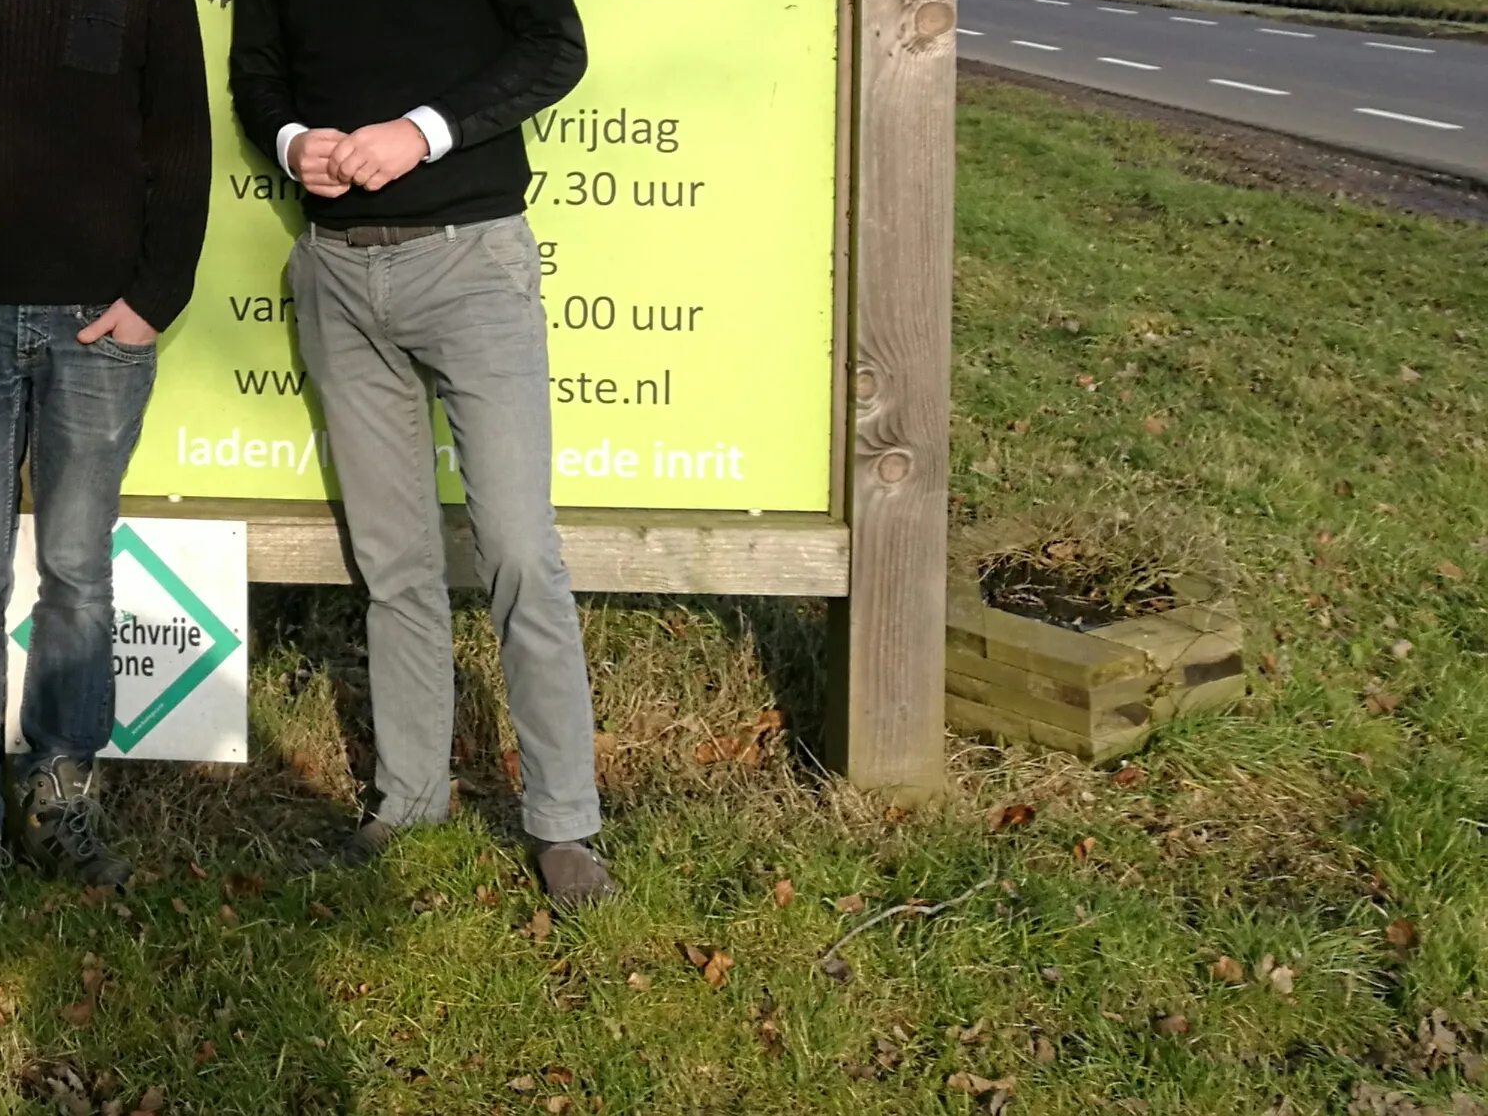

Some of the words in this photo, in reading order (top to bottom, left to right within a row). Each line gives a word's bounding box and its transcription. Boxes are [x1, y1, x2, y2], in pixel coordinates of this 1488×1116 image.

[531, 107, 680, 154] Vrijdag
[229, 174, 301, 200] van
[633, 181, 706, 207] uur
[540, 295, 616, 330] .00
[632, 305, 704, 331] uur
[653, 441, 745, 480] inrit
